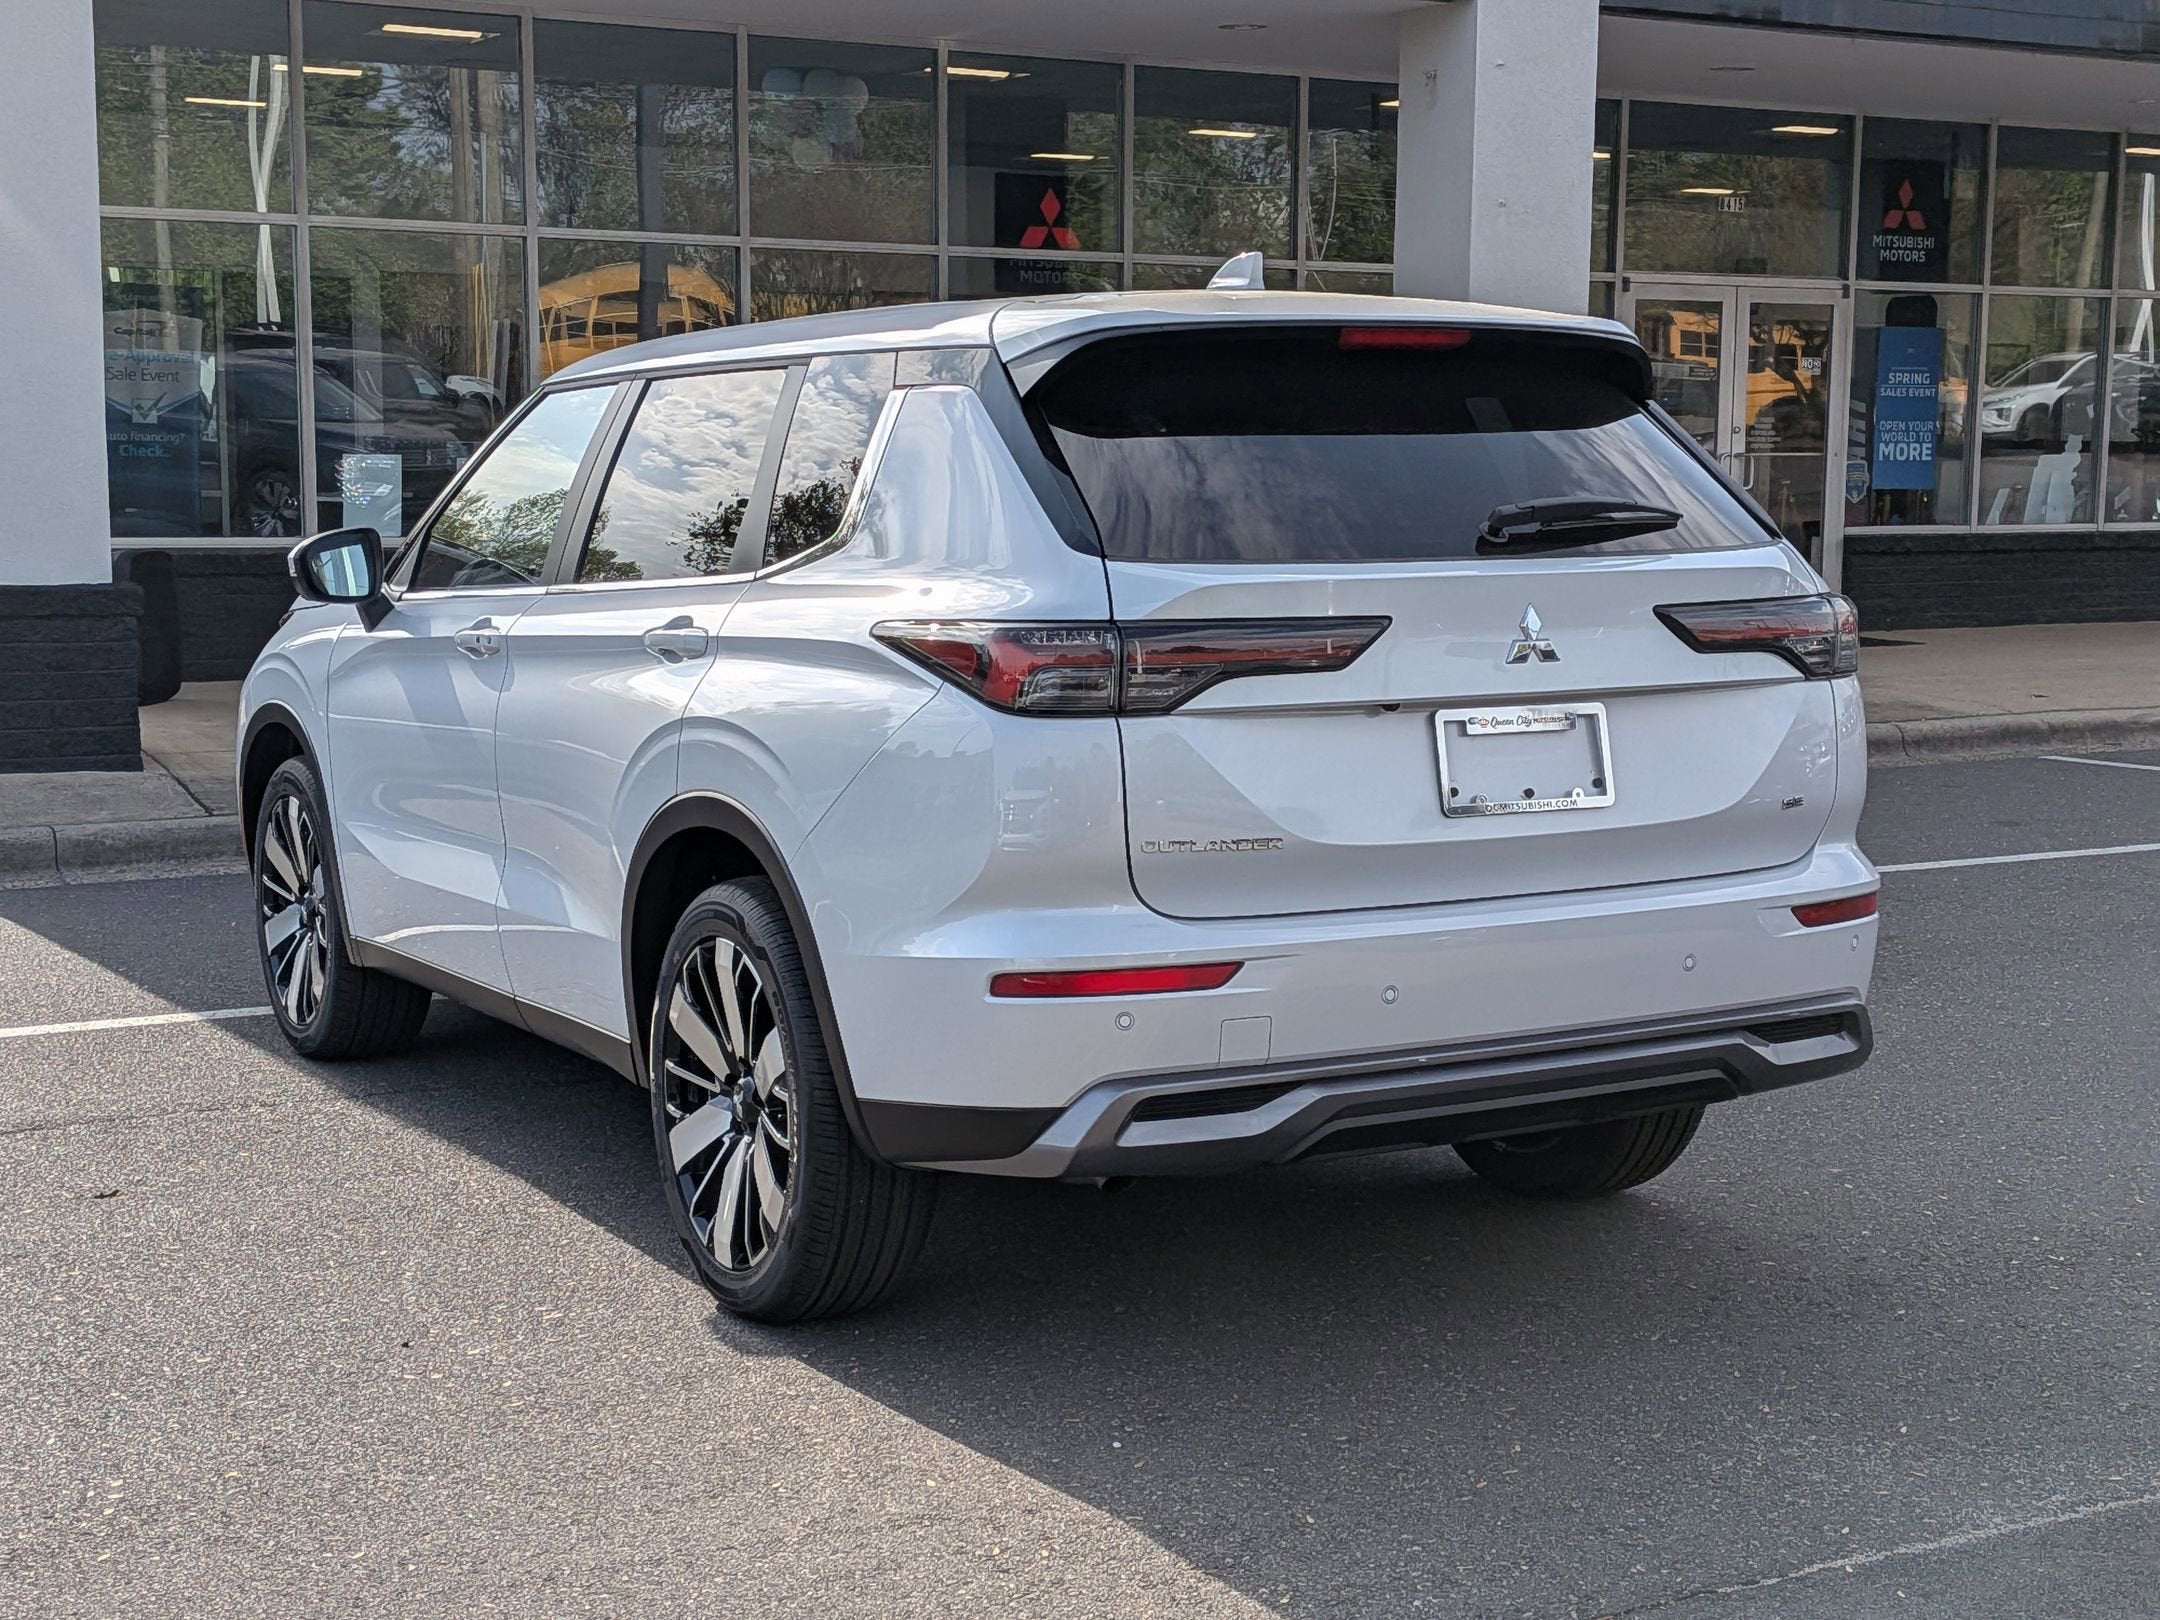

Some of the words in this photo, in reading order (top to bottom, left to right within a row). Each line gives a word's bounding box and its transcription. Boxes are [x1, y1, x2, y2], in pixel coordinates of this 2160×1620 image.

[1872, 234, 1935, 249] MITSUBISHI
[1880, 249, 1926, 262] MOTORS
[106, 366, 137, 381] Sale
[141, 367, 180, 383] Event
[1888, 372, 1931, 385] SPRING
[1880, 387, 1907, 397] SALES
[1909, 387, 1936, 398] EVENT
[1879, 420, 1906, 431] OPEN
[1908, 421, 1934, 432] YOUR
[1881, 432, 1916, 442] WORLD
[1919, 432, 1932, 442] TO
[1878, 443, 1932, 461] MORE
[1490, 716, 1515, 729] Queen
[1516, 714, 1532, 728] City
[1140, 837, 1284, 853] OUTLANDER
